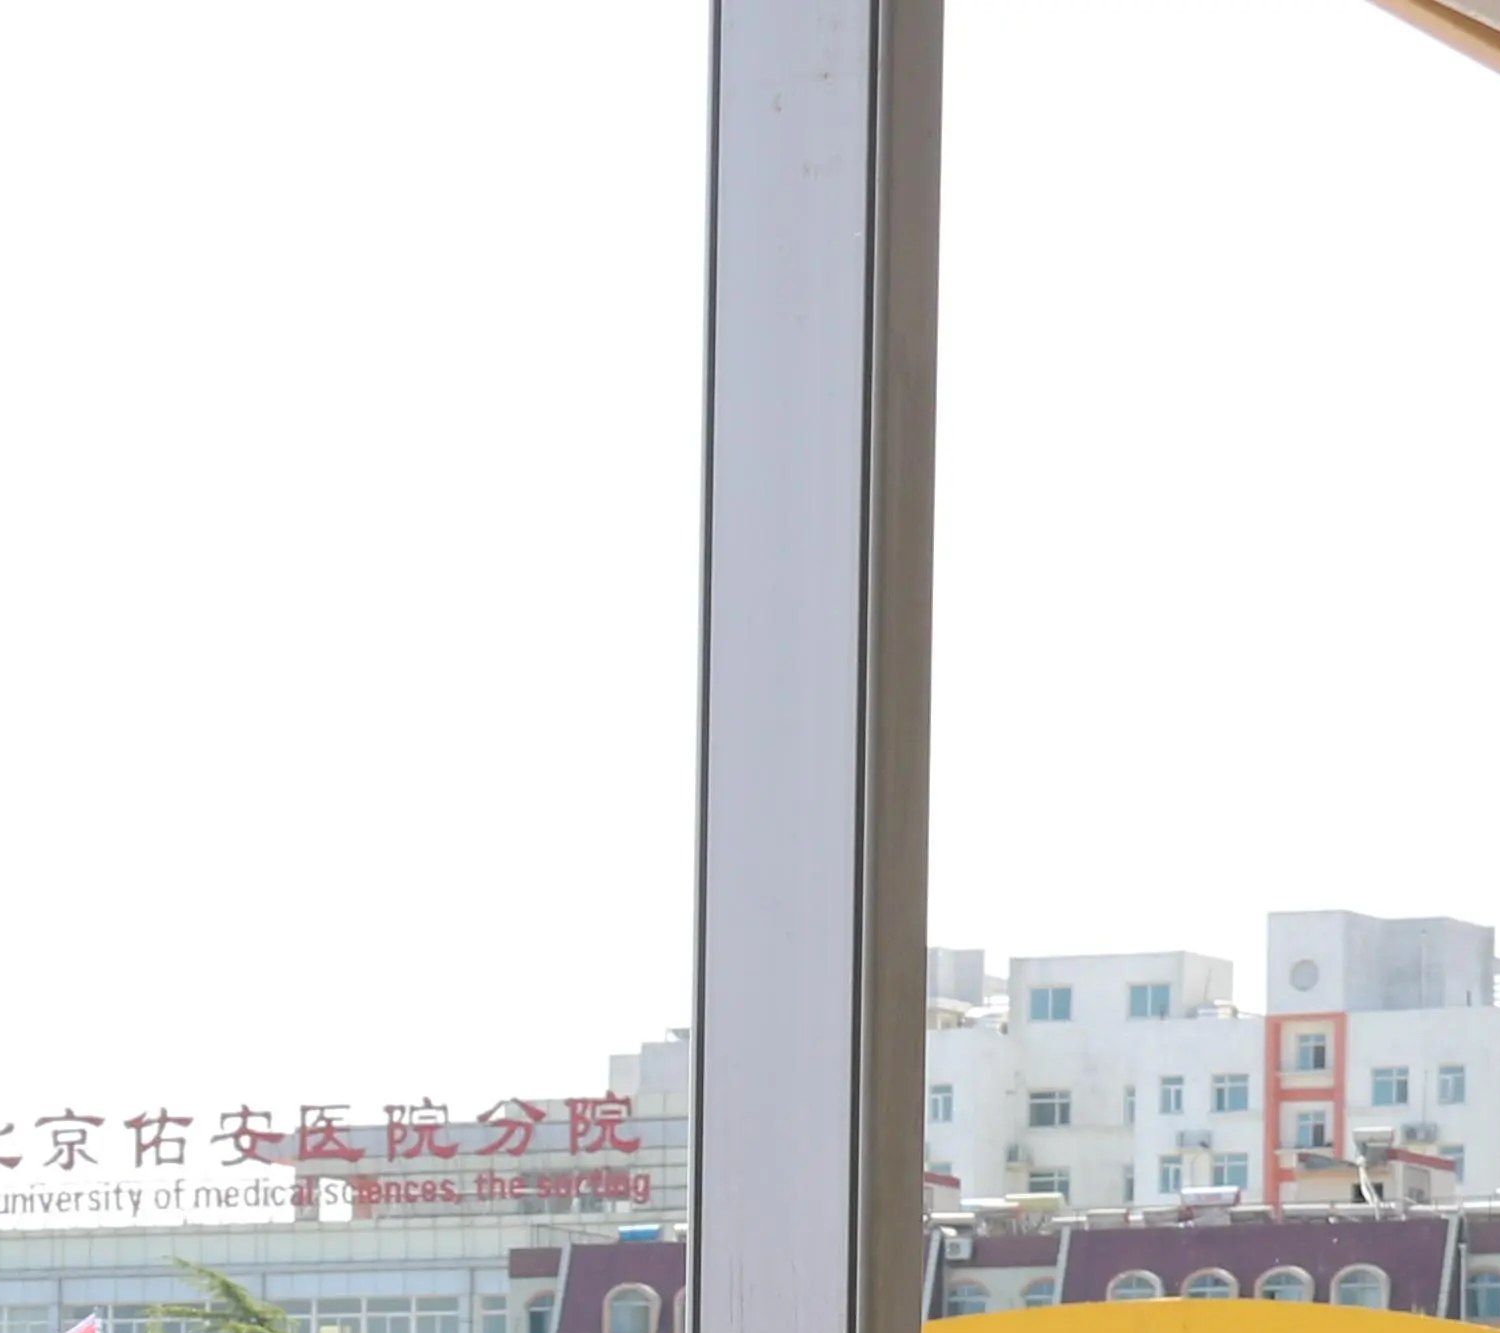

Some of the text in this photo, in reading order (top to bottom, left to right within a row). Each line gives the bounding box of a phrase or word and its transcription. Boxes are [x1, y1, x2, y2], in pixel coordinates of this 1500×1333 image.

[153, 1178, 186, 1208] of
[194, 1176, 314, 1207] medical
[475, 1169, 528, 1200] the
